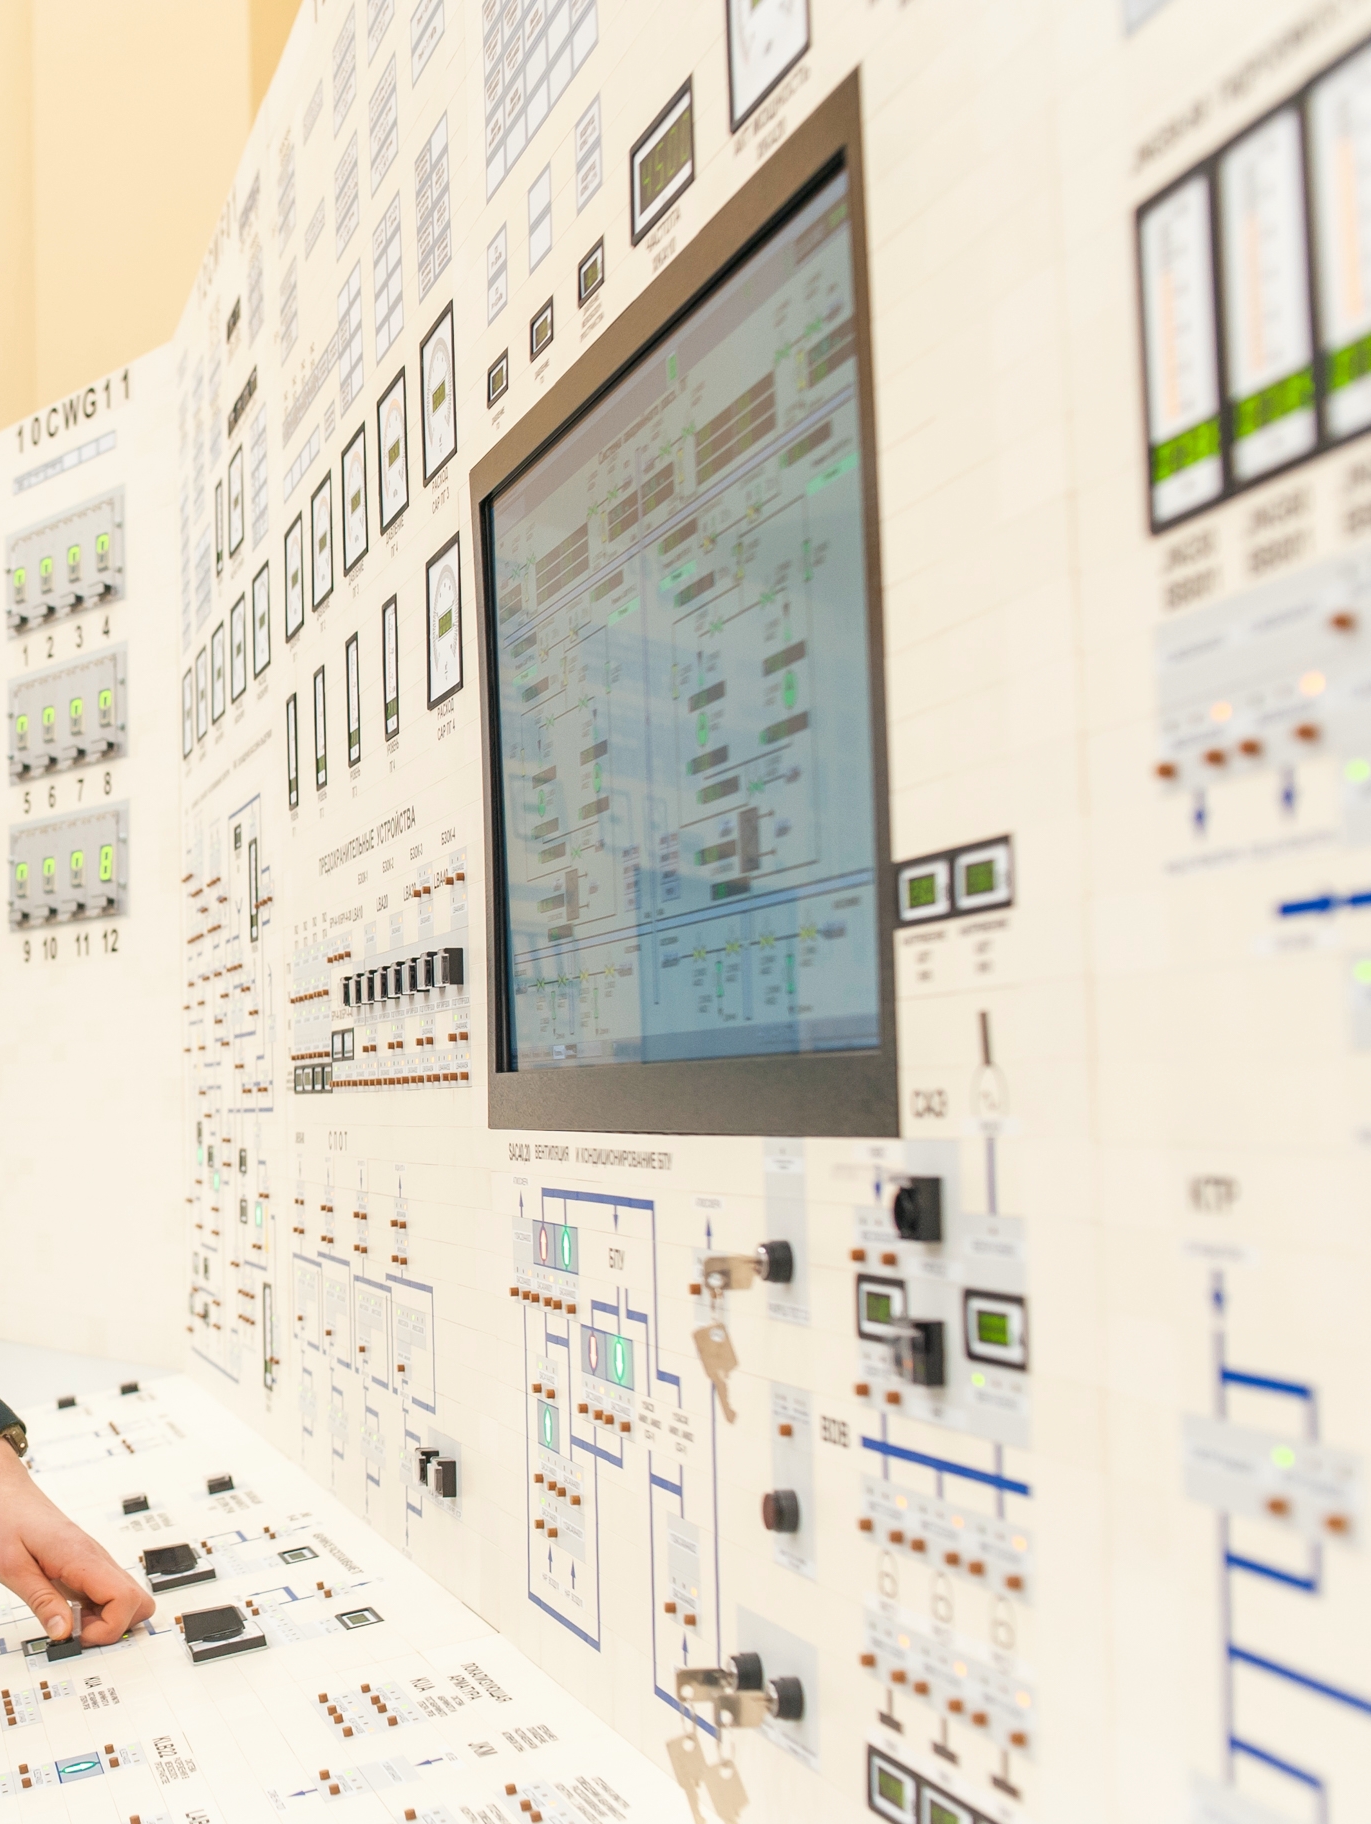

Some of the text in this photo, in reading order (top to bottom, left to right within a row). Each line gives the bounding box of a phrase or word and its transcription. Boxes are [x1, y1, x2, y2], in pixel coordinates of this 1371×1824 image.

[16, 368, 129, 454] 10CWG11
[47, 636, 54, 659] 2
[75, 625, 83, 648] 3
[102, 615, 110, 638] 4
[437, 697, 454, 720] РАСХОД
[23, 771, 112, 814] 5 6 7 8
[318, 806, 416, 877] ПРЕДОХРАНИТЕЛЬНЫЕ УСТРОЙСТВА
[23, 928, 118, 963] 9 10 11 12
[534, 1143, 569, 1165] ВЕНТИЛЯЦИЯ
[581, 1147, 656, 1170] КОНДИЦИОНИРОВАНИЕ
[447, 1674, 483, 1702] АРМАТУРА
[460, 1662, 513, 1704] ЛОКАЛИЗУЮЩАЯ
[152, 1735, 178, 1759] KLB22
